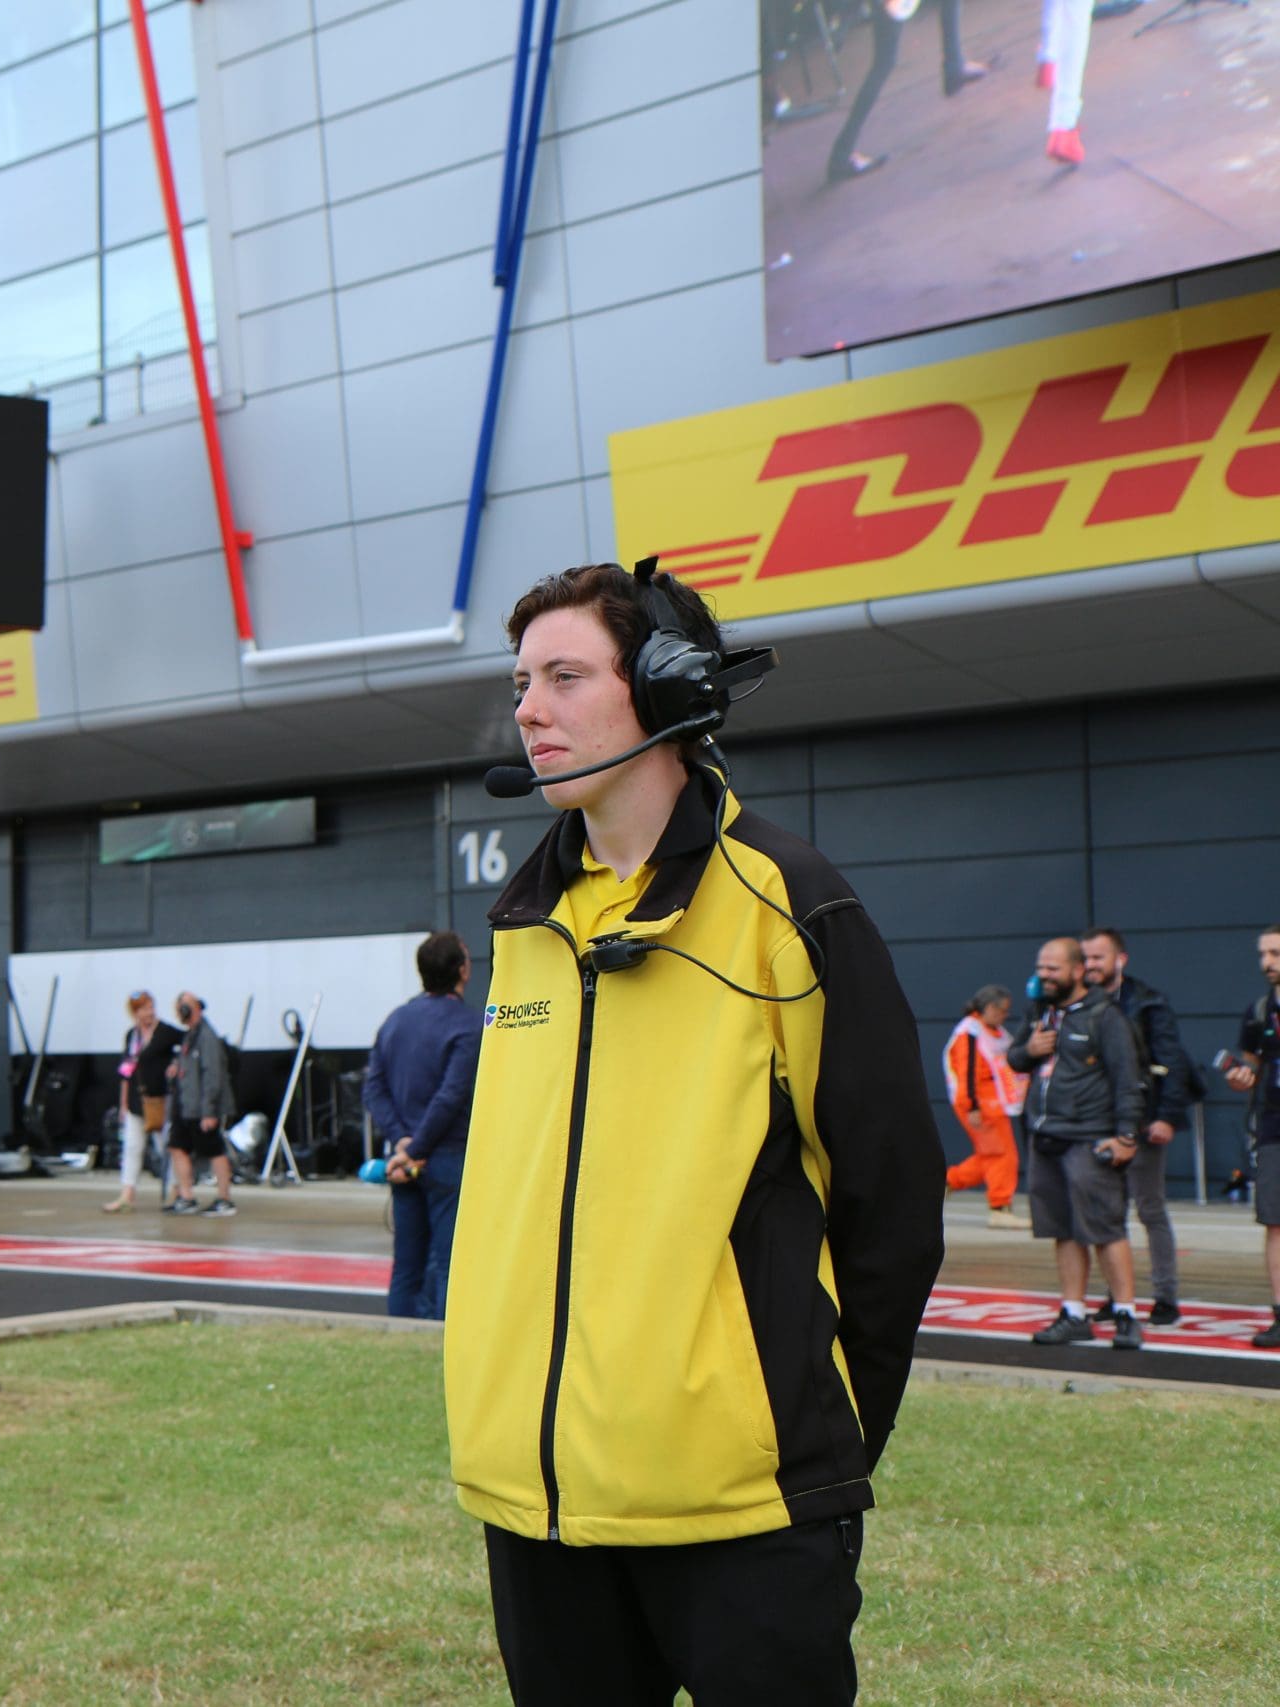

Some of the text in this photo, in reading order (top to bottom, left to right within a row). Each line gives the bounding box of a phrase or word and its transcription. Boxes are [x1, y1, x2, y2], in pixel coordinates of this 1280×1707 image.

[756, 334, 1280, 581] DH
[458, 830, 508, 884] 16
[497, 1000, 551, 1020] SHOWSEC
